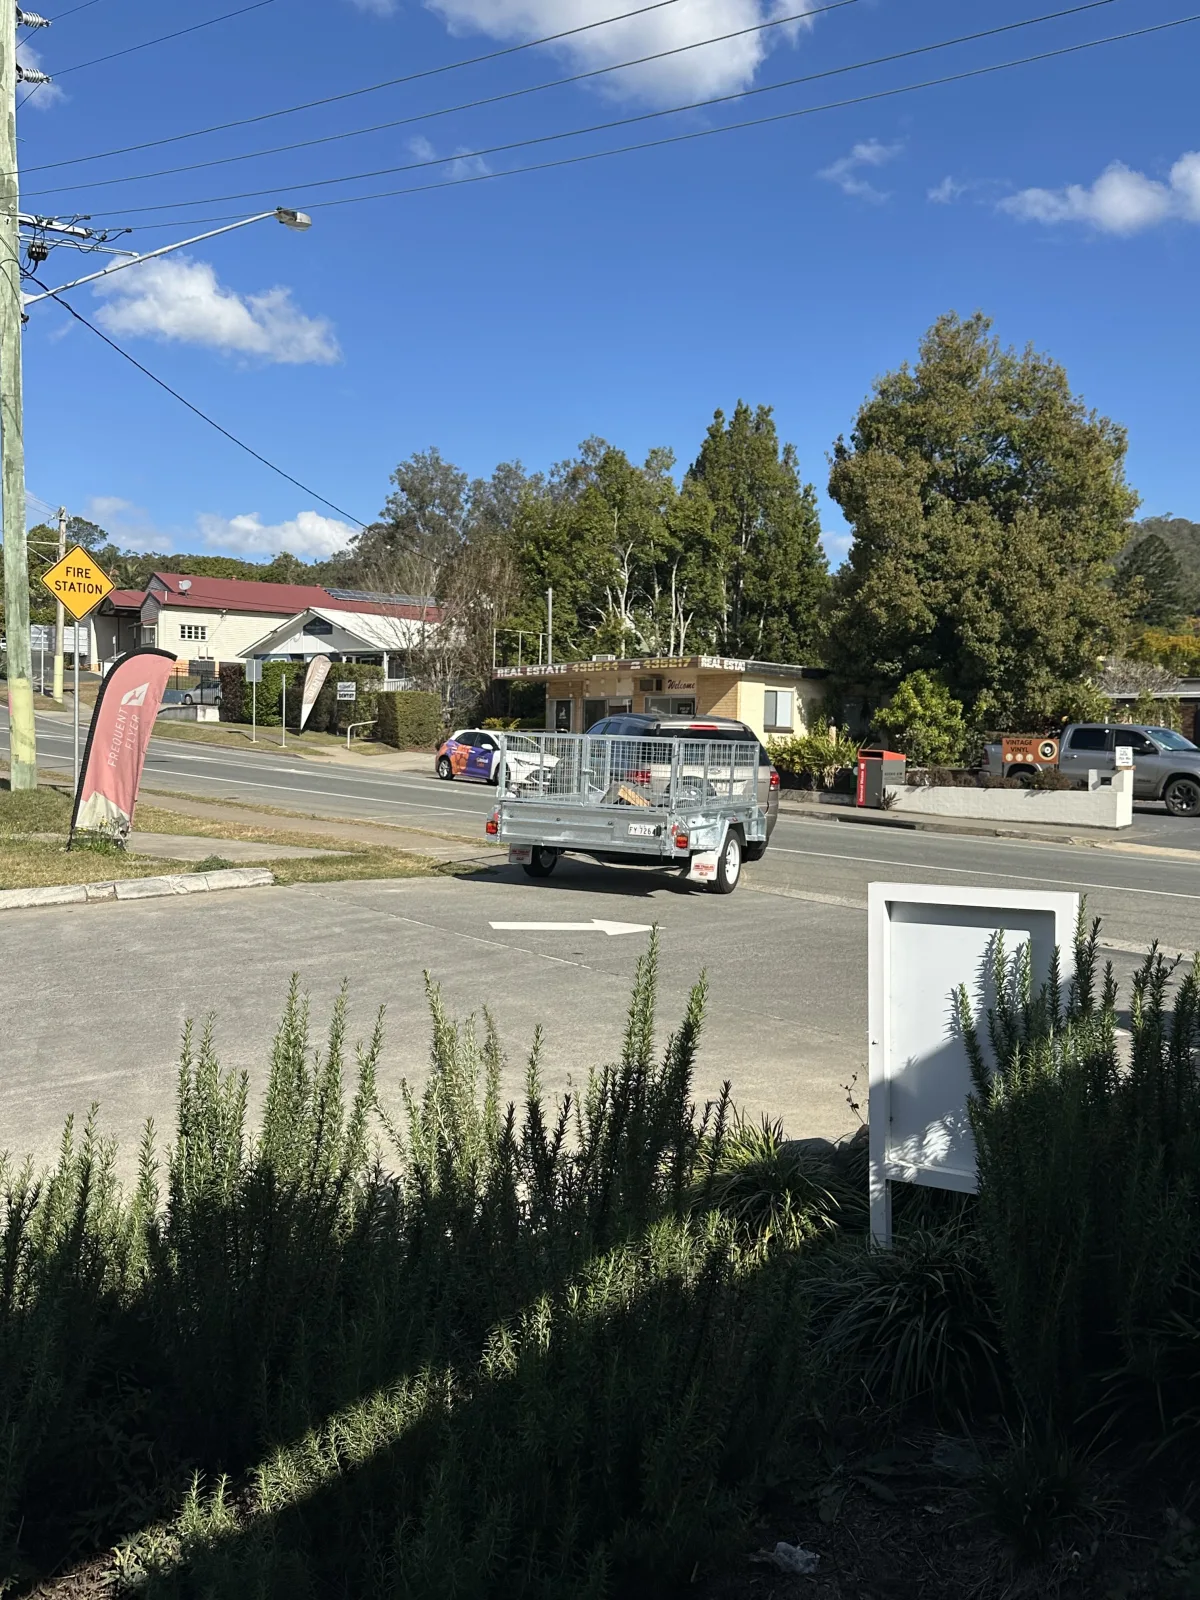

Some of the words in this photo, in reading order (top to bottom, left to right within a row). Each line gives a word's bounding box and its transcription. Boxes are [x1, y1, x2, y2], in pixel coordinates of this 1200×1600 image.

[65, 566, 92, 579] FIRE
[54, 580, 103, 595] STATION
[497, 667, 523, 678] REAL
[526, 664, 568, 676] ESTATE
[643, 657, 692, 669] 435217
[701, 657, 723, 669] REAL
[307, 663, 327, 699] DENTIST
[667, 679, 696, 690] Welcome
[107, 706, 128, 768] FREQUENT
[124, 714, 141, 750] FLYER
